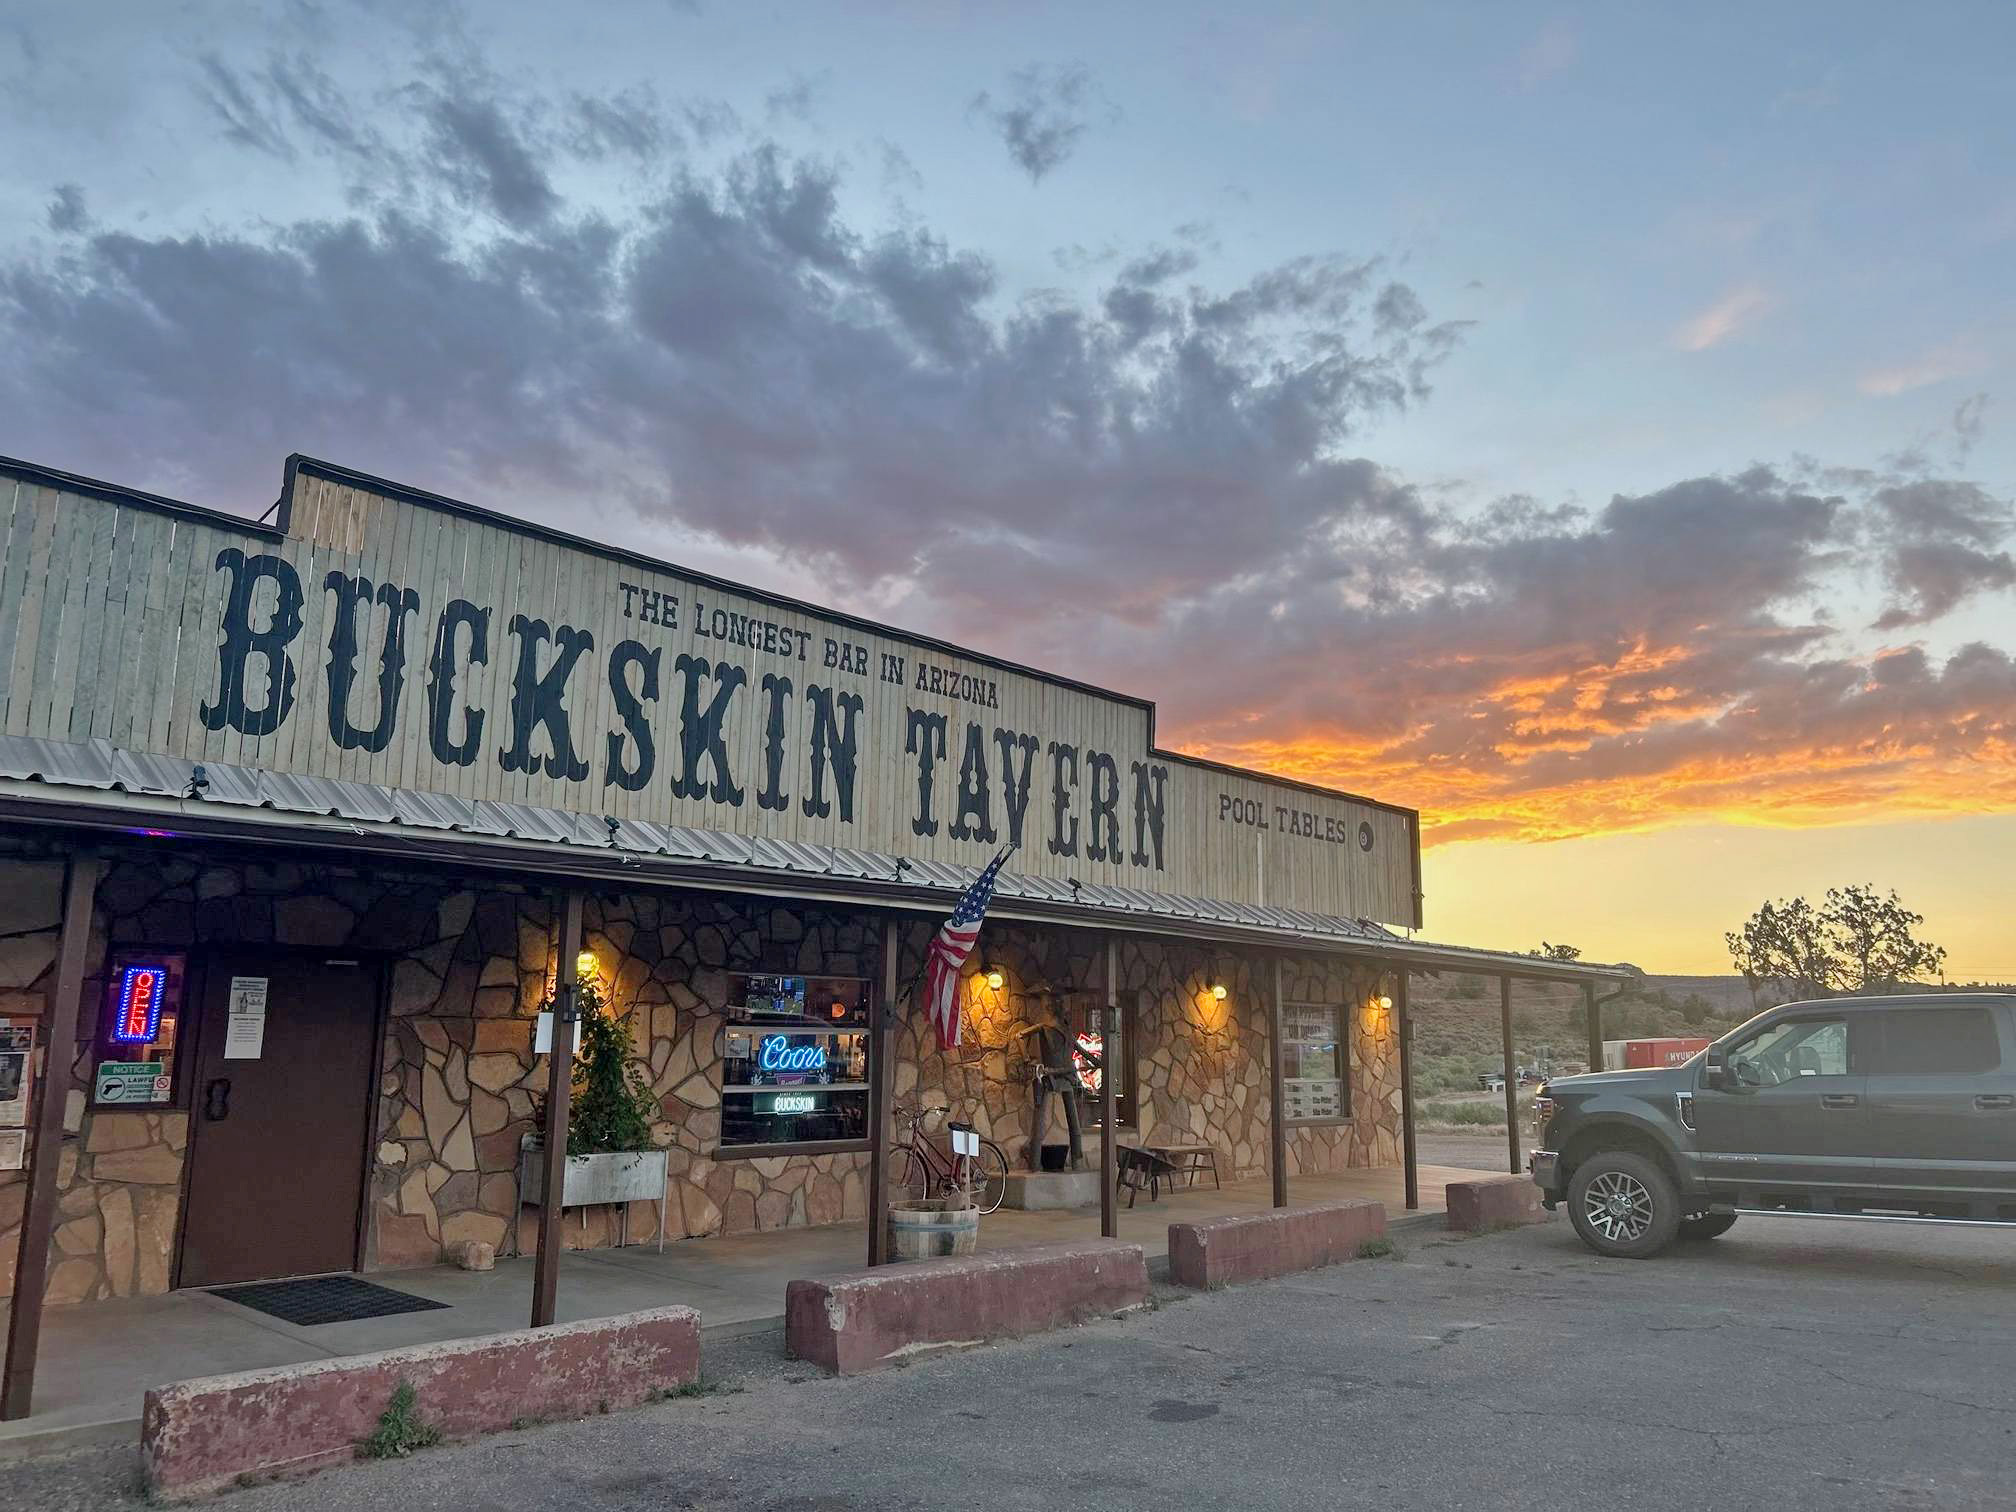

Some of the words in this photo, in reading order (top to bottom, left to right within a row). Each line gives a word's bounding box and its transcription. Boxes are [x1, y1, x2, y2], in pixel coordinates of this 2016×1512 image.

[619, 582, 679, 629] THE
[695, 603, 811, 661] LONGEST
[824, 638, 869, 677] BAR
[881, 653, 904, 685] IN
[915, 662, 998, 710] ARIZONA
[200, 547, 864, 824] BUCKSKIN
[905, 706, 1168, 871] TAVERN
[1218, 793, 1269, 830] POOL
[1275, 806, 1346, 845] TABLES
[129, 972, 153, 1036] OPEN
[112, 1066, 151, 1074] NOTICE
[763, 1035, 826, 1069] Coors
[774, 1096, 815, 1112] BUCKSKIN
